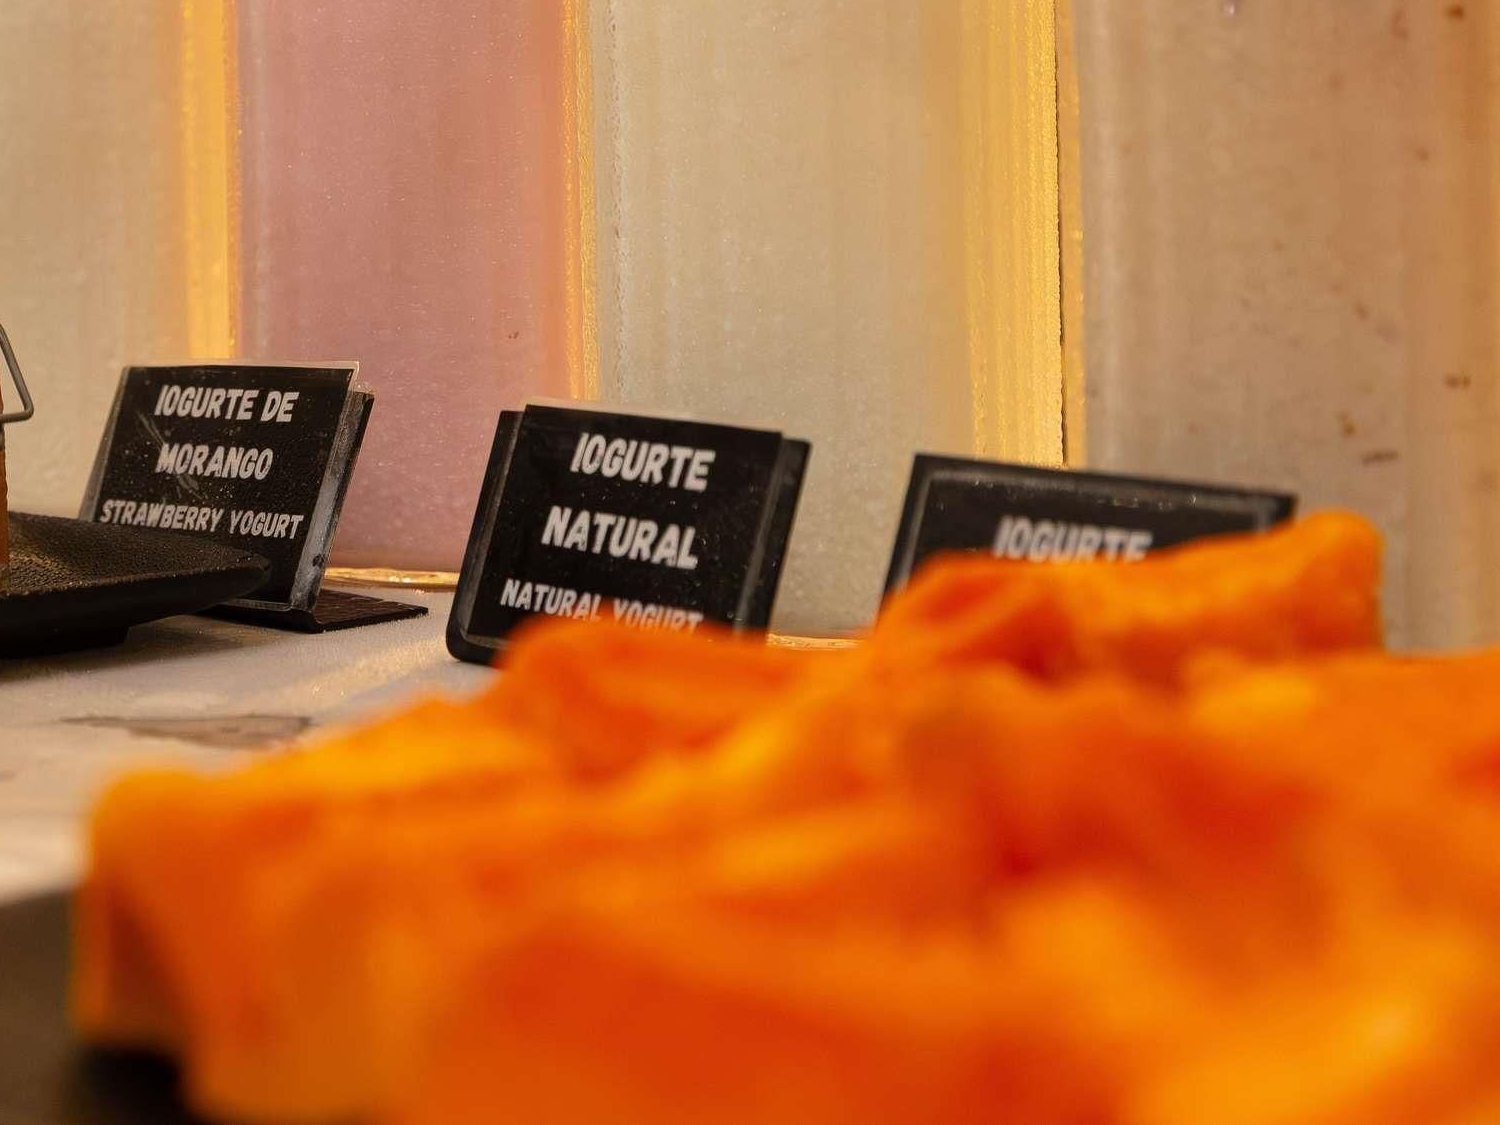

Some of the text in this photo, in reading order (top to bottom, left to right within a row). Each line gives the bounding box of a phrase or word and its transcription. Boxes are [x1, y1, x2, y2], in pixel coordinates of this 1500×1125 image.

[154, 384, 300, 422] IOGURTE DE
[155, 443, 273, 480] MORANGO
[570, 432, 716, 492] IOGURTE
[100, 499, 303, 540] STRAWBERRY YOGURT
[541, 505, 698, 570] NATURAL
[500, 578, 602, 621] NATURAL
